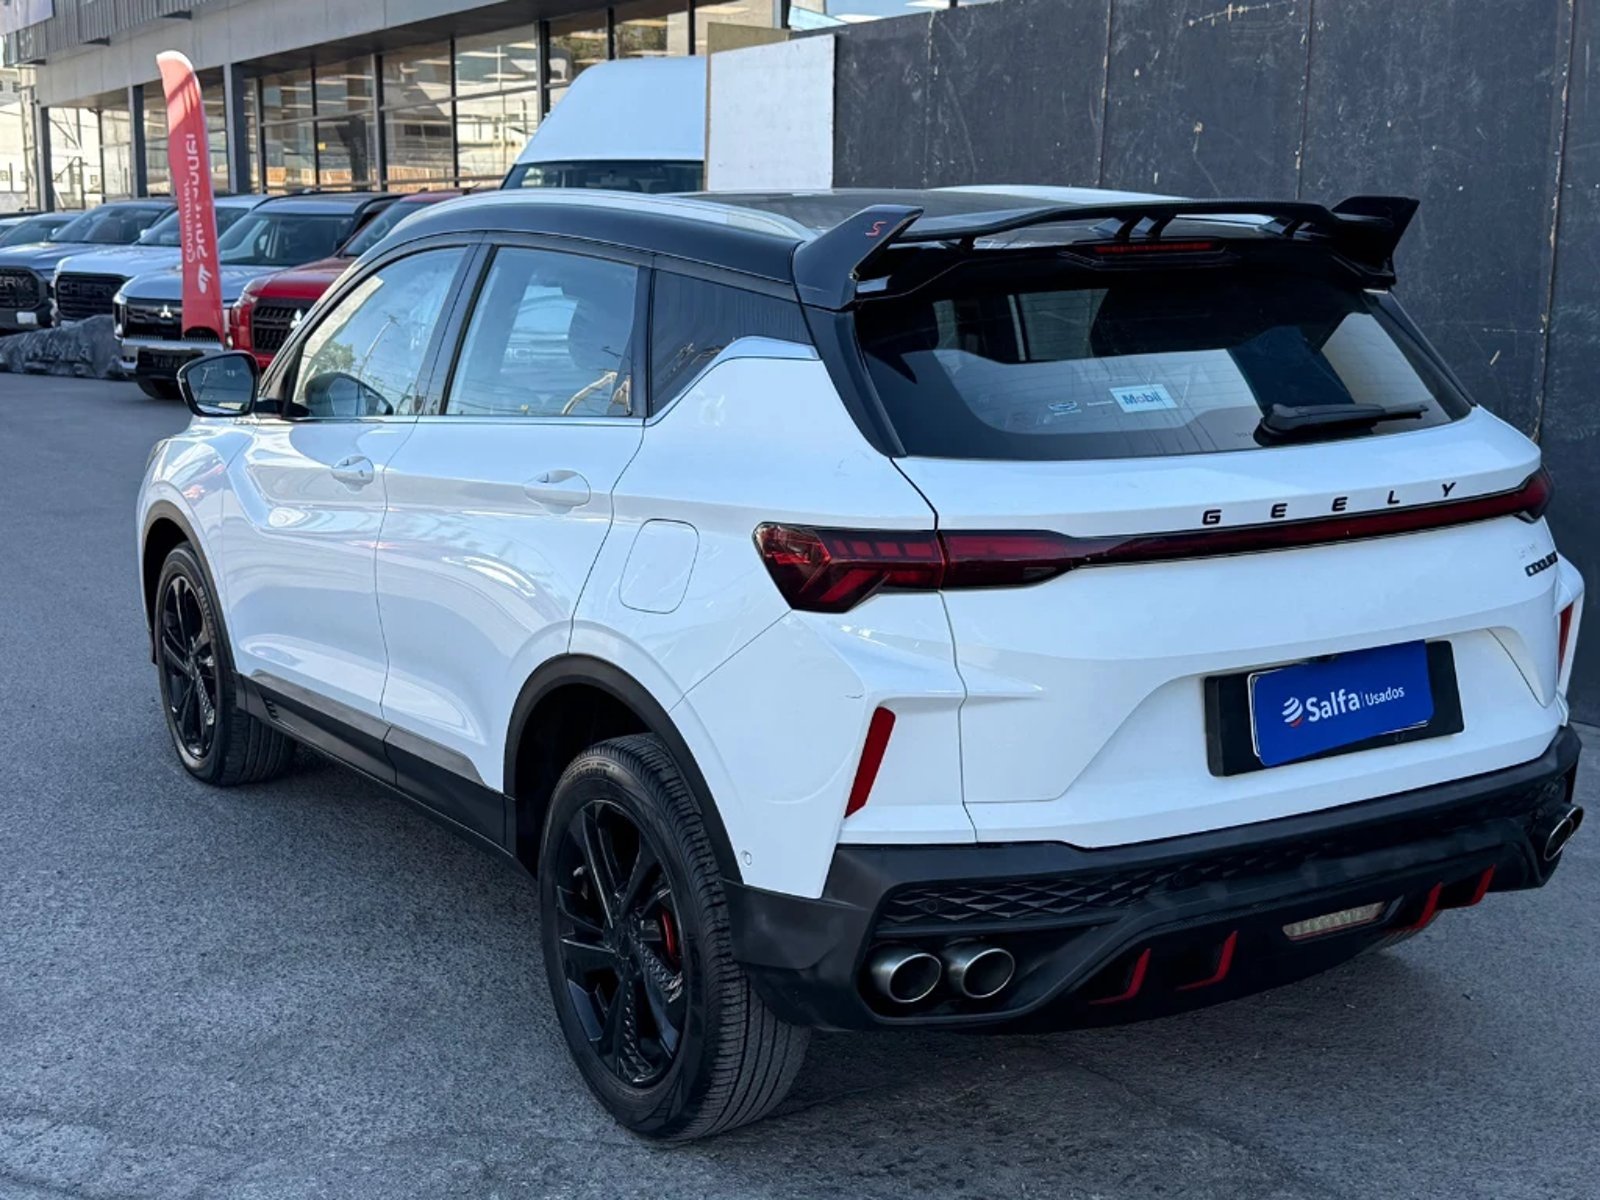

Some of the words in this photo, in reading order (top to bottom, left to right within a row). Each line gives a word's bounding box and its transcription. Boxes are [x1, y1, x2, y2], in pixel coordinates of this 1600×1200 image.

[864, 220, 888, 237] S
[1121, 391, 1162, 405] Mobil
[1202, 482, 1457, 526] GEELY
[1305, 688, 1361, 722] Salfa
[1364, 686, 1405, 706] Usados
